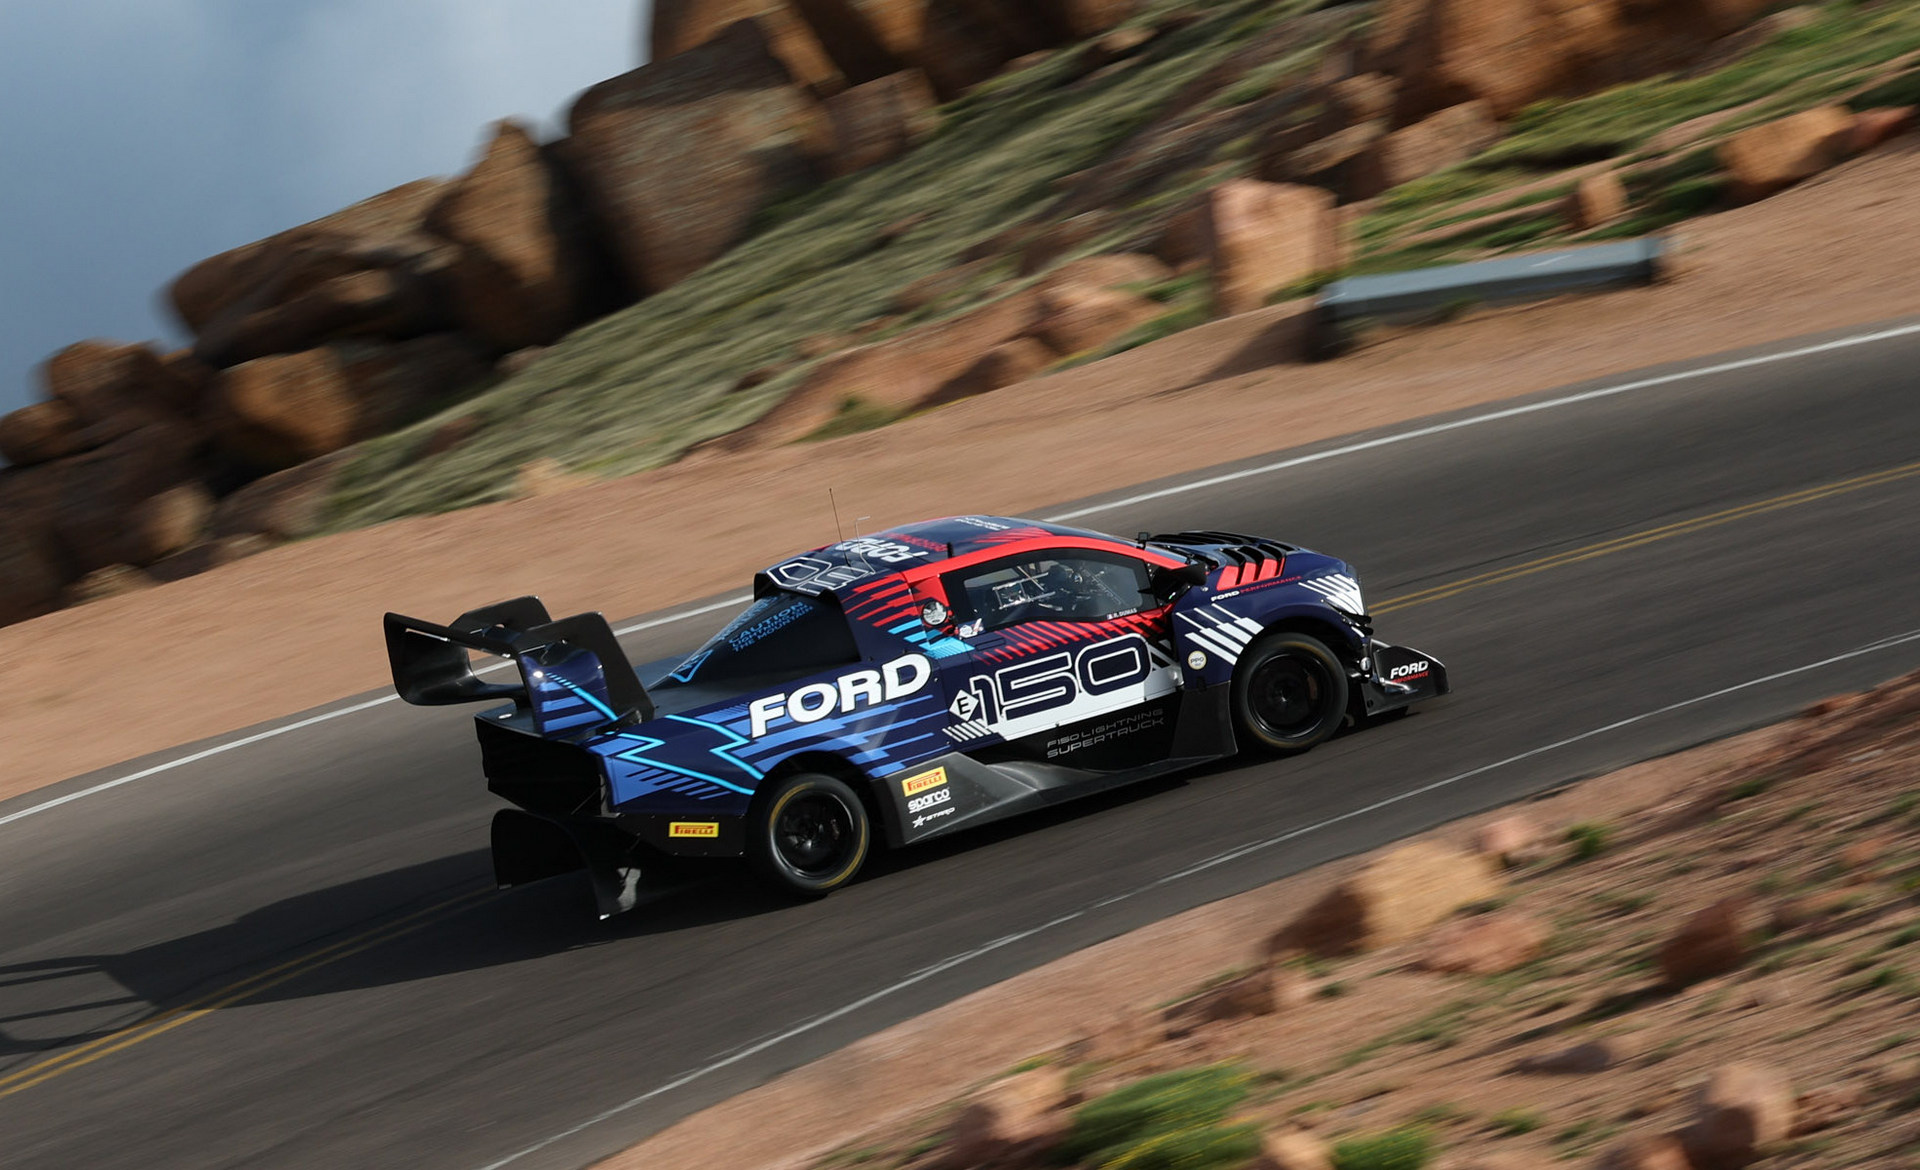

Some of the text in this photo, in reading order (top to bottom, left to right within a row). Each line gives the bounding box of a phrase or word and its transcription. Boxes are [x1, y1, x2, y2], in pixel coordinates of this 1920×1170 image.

[1211, 590, 1240, 602] FORD
[728, 601, 804, 645] CAUTION
[969, 633, 1152, 729] 150
[1390, 660, 1429, 680] FORD
[749, 653, 931, 739] FORD
[1047, 717, 1165, 759] SUPERTRUCK
[907, 771, 942, 792] PIRELLI
[907, 788, 951, 812] sparco
[674, 825, 715, 835] PIRELLI
